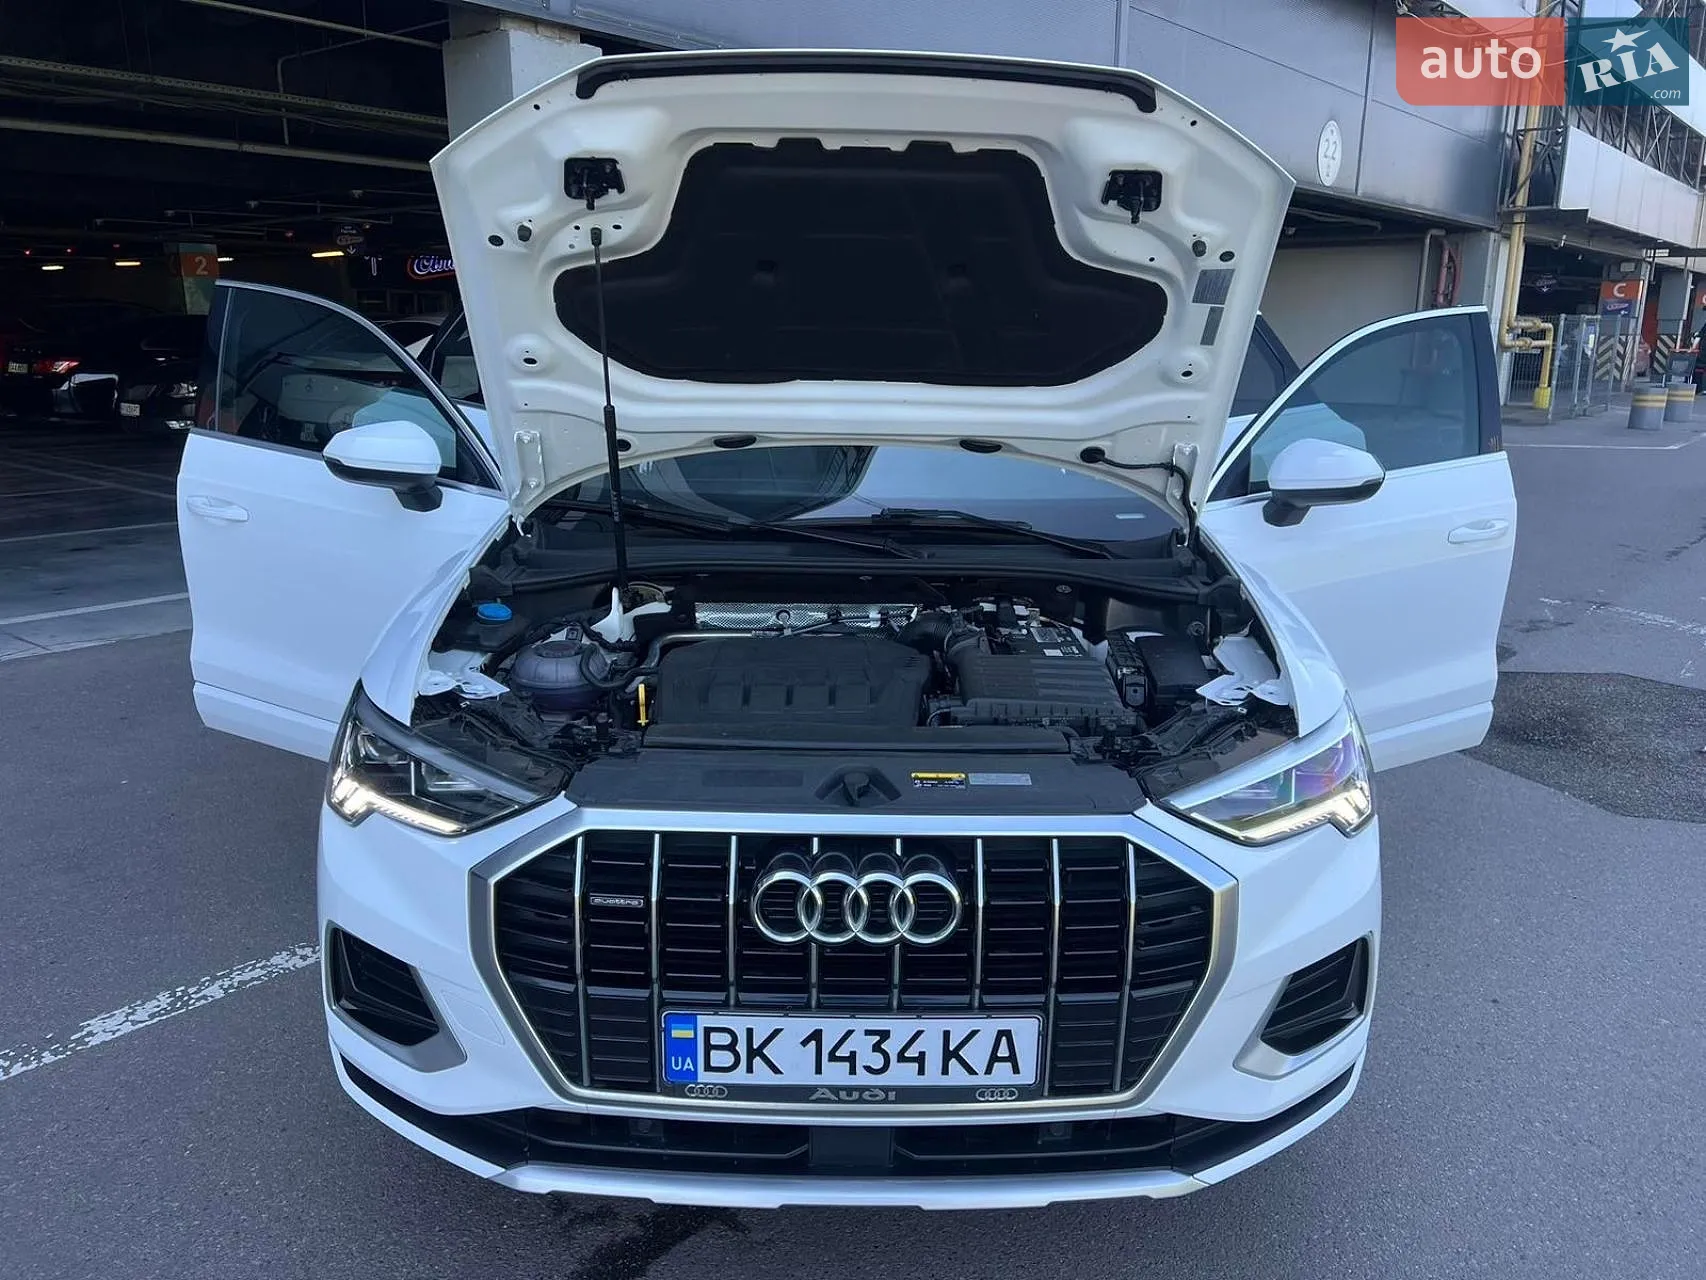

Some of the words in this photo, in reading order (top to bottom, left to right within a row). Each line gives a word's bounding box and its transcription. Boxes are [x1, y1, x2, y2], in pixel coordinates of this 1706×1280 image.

[194, 255, 209, 275] 2
[1613, 282, 1627, 297] C
[703, 1026, 785, 1075] BK
[800, 1028, 926, 1076] 1434
[941, 1029, 1021, 1076] KA
[671, 1056, 695, 1072] UA
[808, 1087, 896, 1101] Audi
